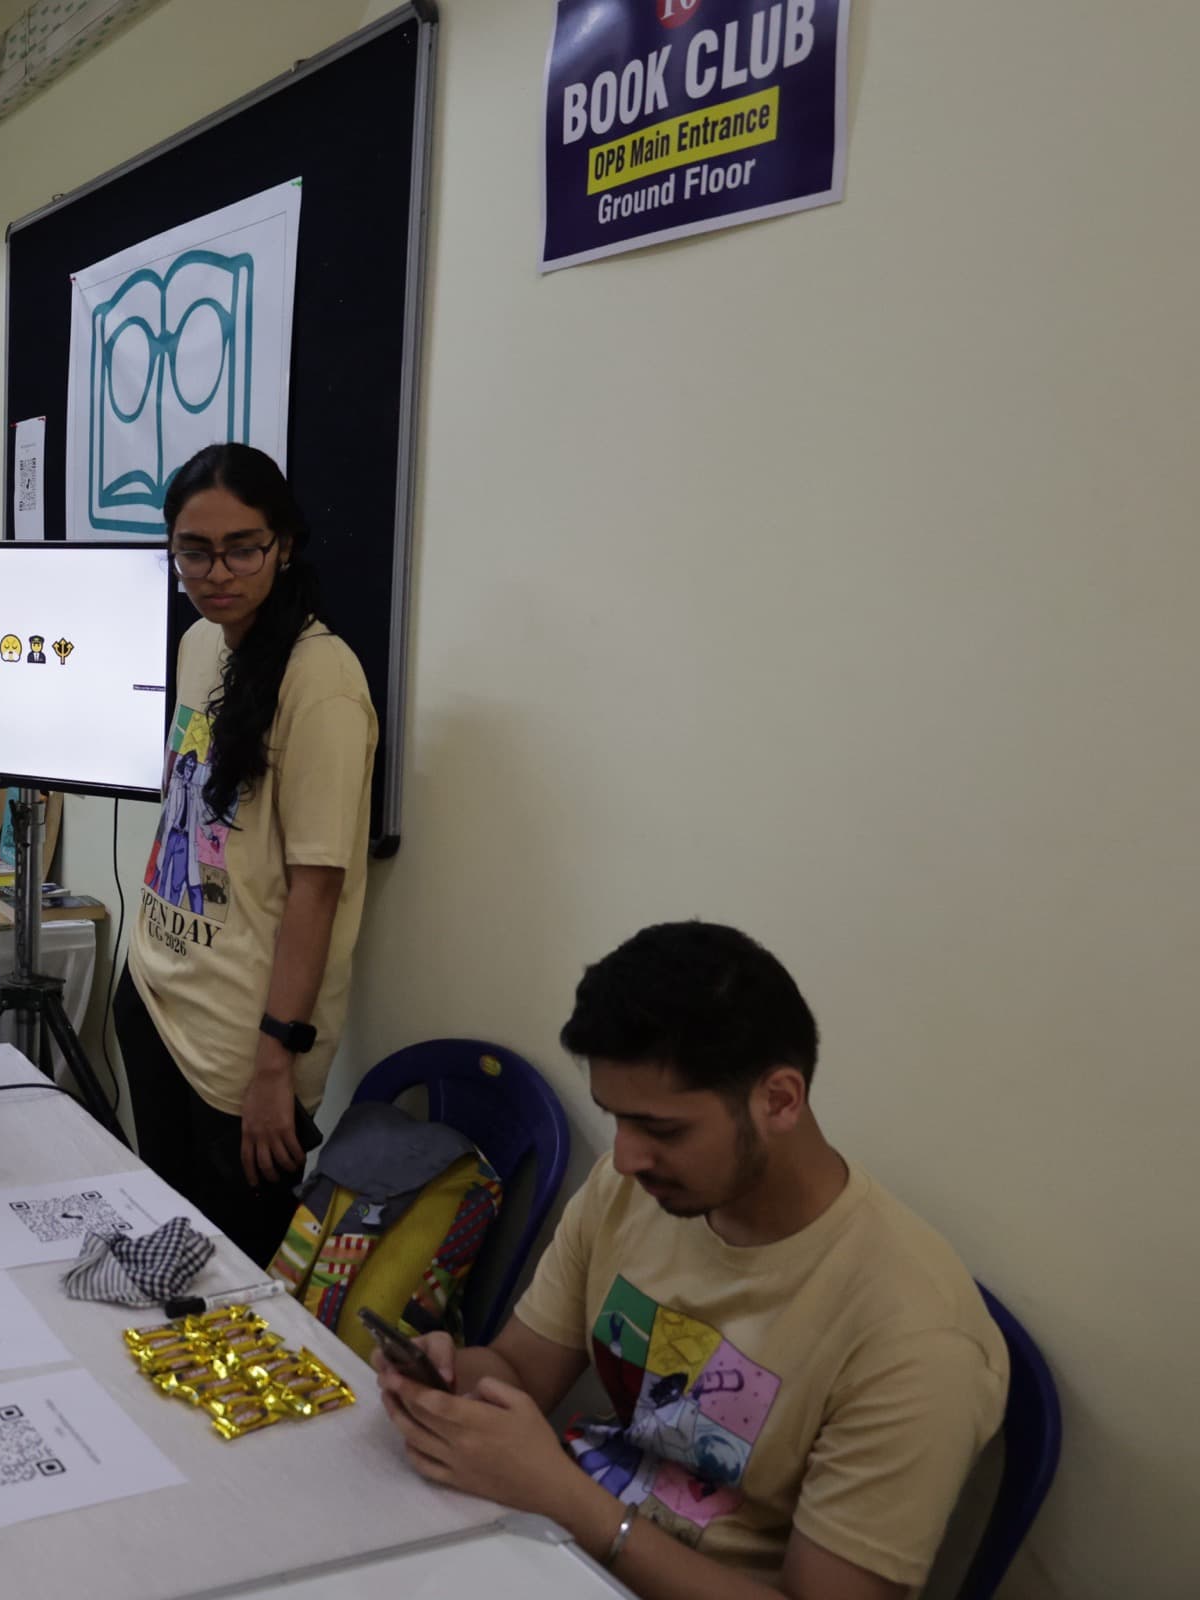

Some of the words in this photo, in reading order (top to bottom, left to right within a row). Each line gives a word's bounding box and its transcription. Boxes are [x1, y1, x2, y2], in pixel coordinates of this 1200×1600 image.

[563, 45, 672, 145] BOOK
[684, 0, 815, 99] CLUB
[594, 144, 626, 181] OPB
[630, 131, 670, 168] Main
[677, 104, 770, 152] Entrance
[598, 174, 675, 224] Ground
[684, 158, 756, 200] Floor
[164, 931, 187, 956] 2026
[172, 911, 222, 948] DAY
